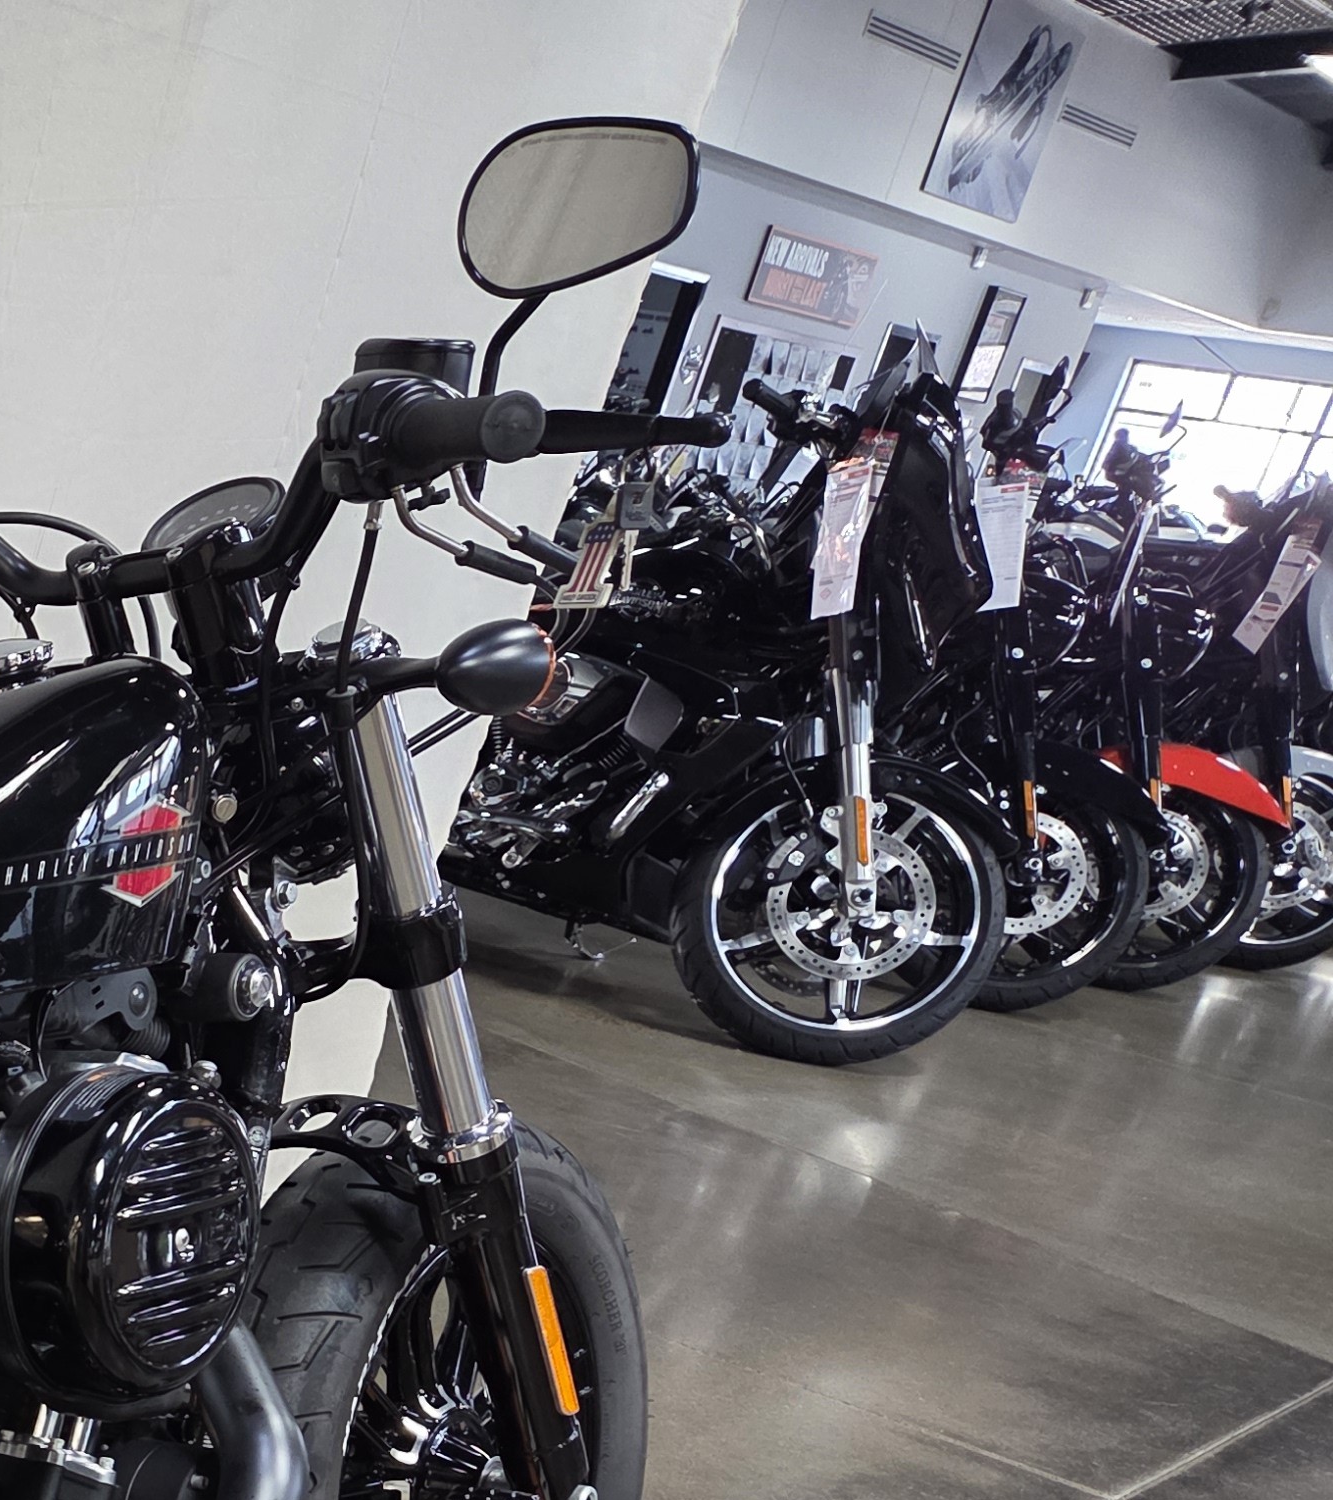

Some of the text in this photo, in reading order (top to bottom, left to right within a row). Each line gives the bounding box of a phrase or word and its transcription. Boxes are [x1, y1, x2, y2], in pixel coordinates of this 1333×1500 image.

[764, 234, 830, 278] NEW ARRIVALS
[588, 1254, 624, 1333] SCORCHER
